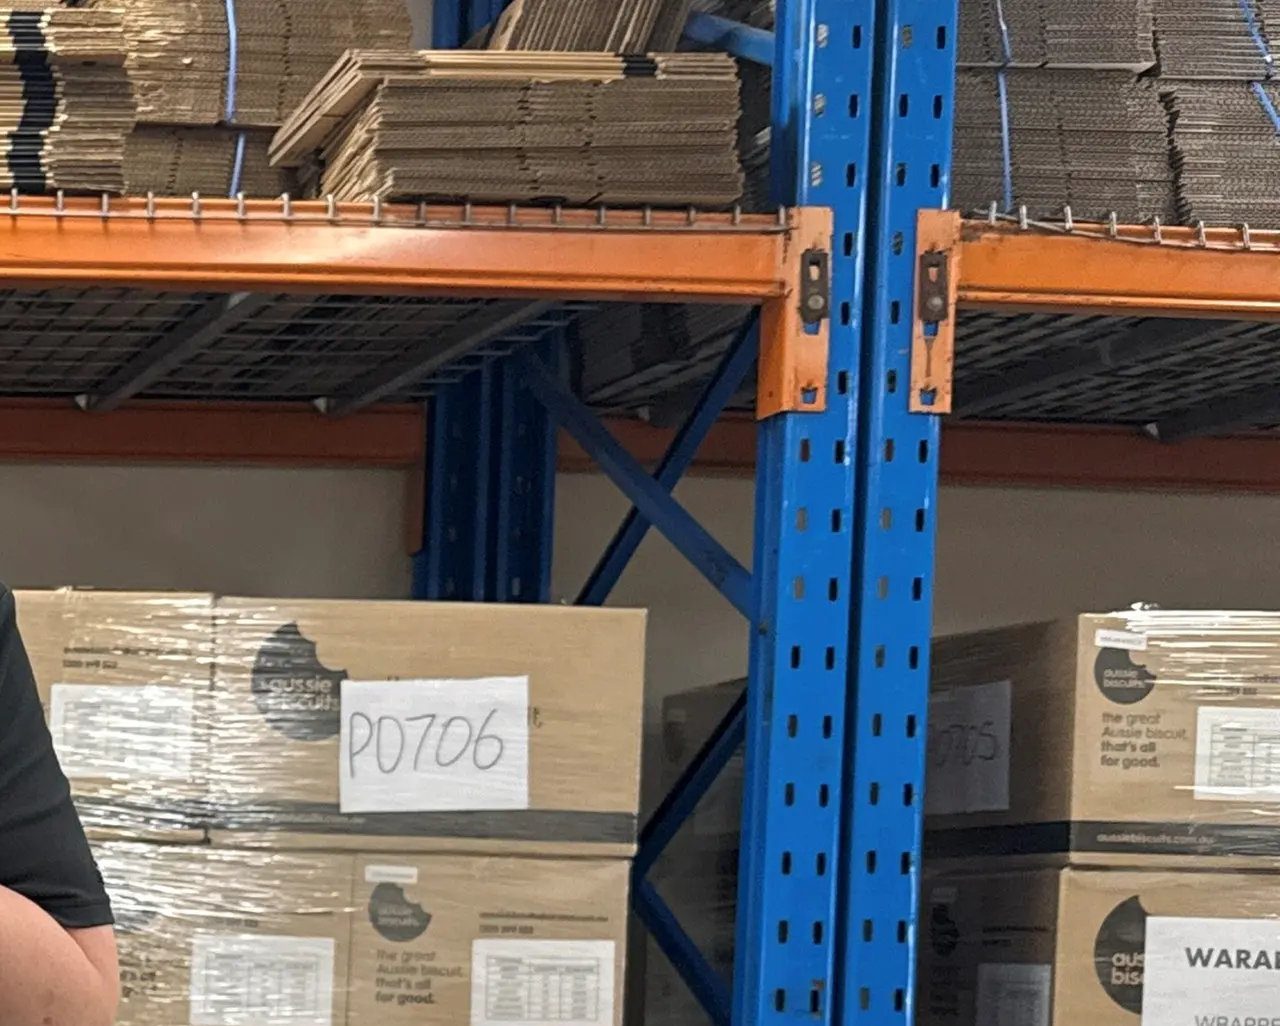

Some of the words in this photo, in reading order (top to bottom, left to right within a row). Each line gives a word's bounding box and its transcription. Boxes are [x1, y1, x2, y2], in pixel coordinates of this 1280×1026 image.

[1101, 741, 1137, 752] that's
[1140, 742, 1157, 753] all
[1101, 755, 1120, 766] for
